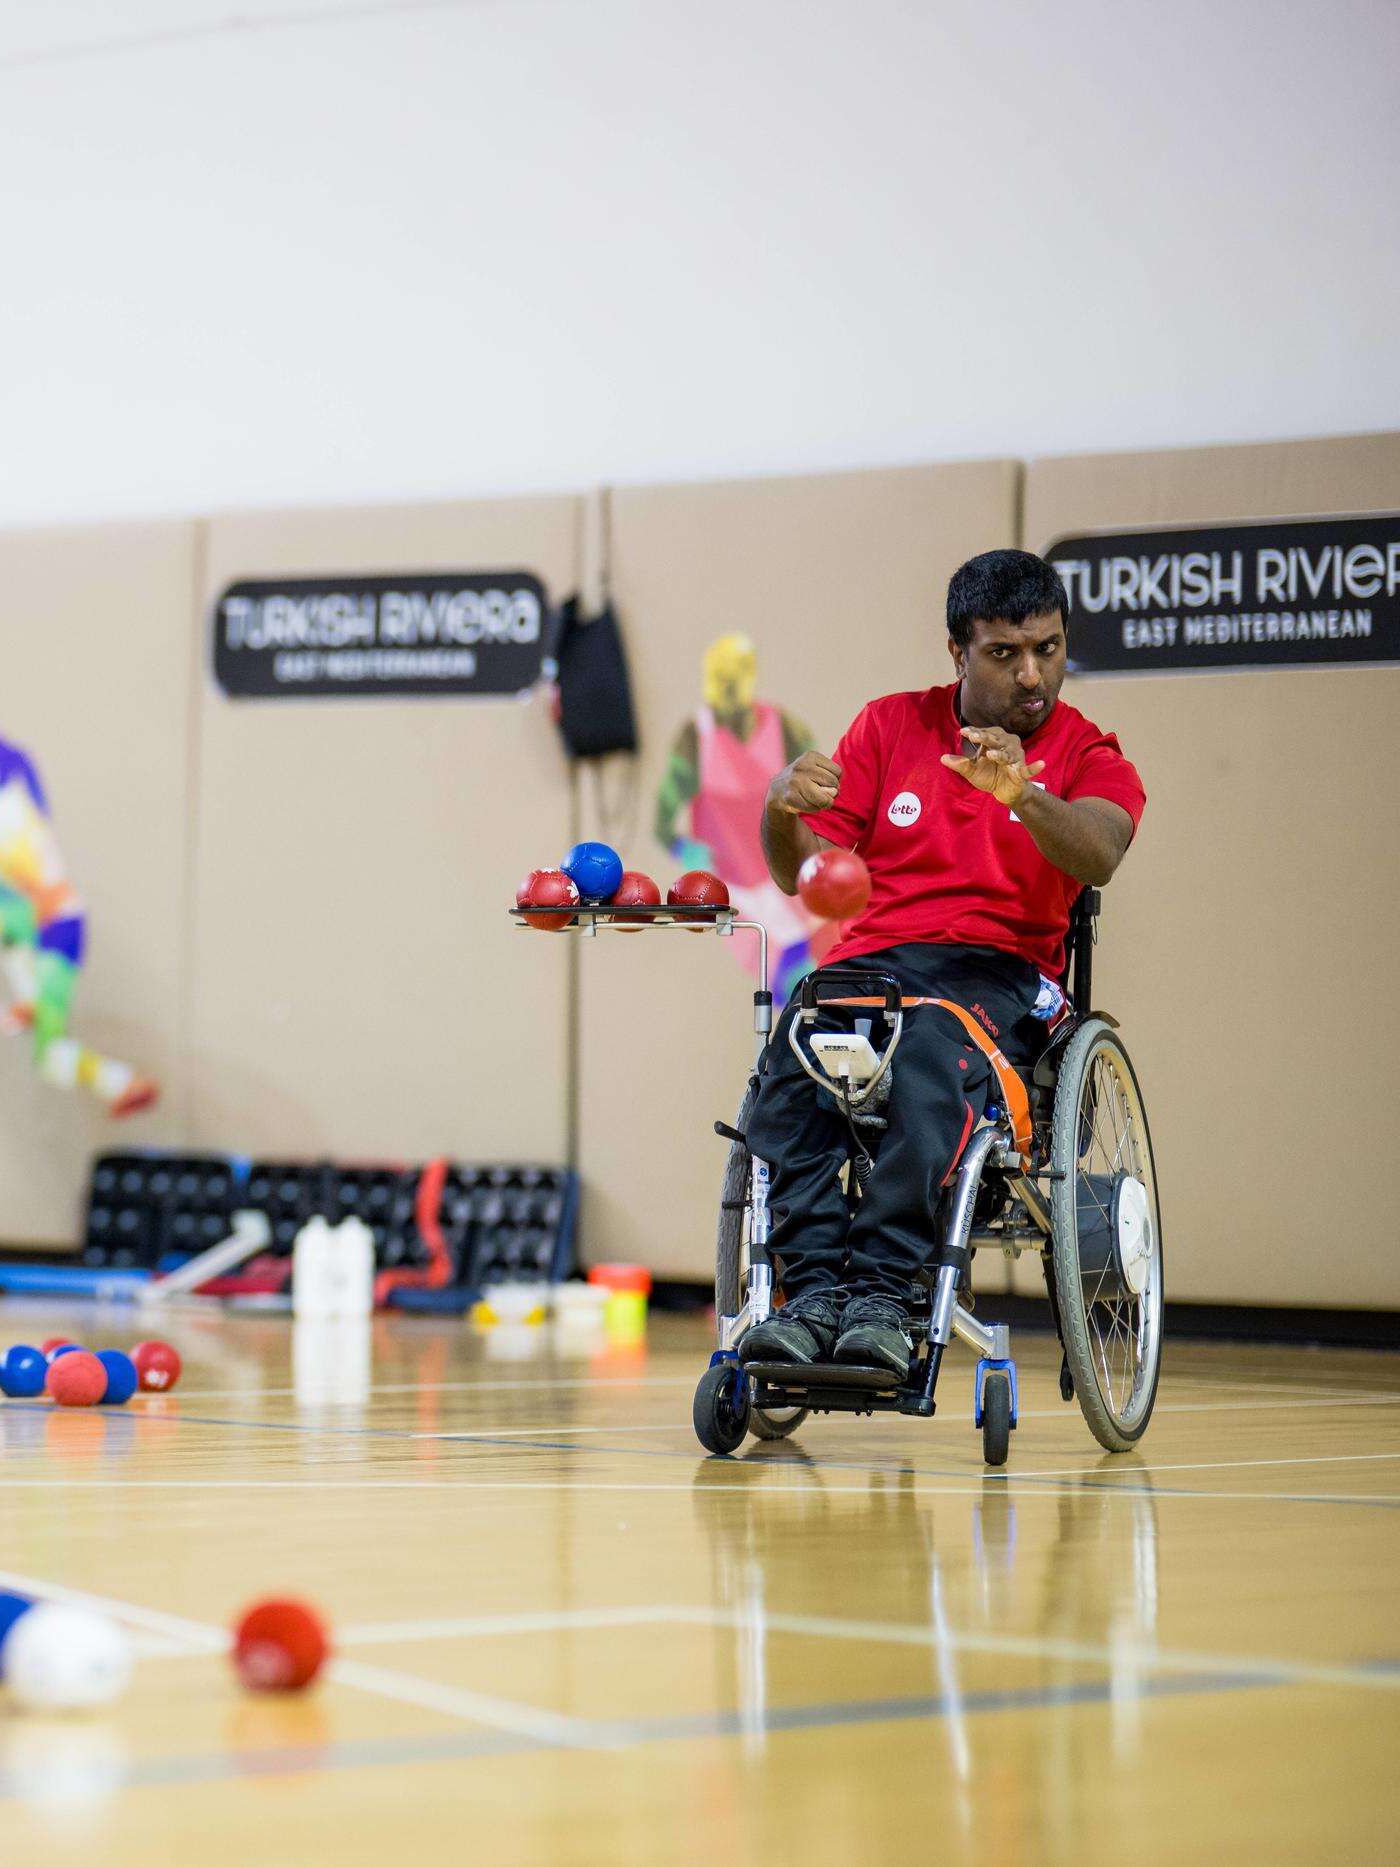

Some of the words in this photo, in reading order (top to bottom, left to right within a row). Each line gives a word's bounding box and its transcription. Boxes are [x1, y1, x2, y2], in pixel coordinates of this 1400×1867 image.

[1052, 550, 1242, 613] TURKISH
[1122, 615, 1179, 649] EAST
[1184, 609, 1373, 645] MEDITERRANEAN
[970, 1003, 999, 1037] JAKO
